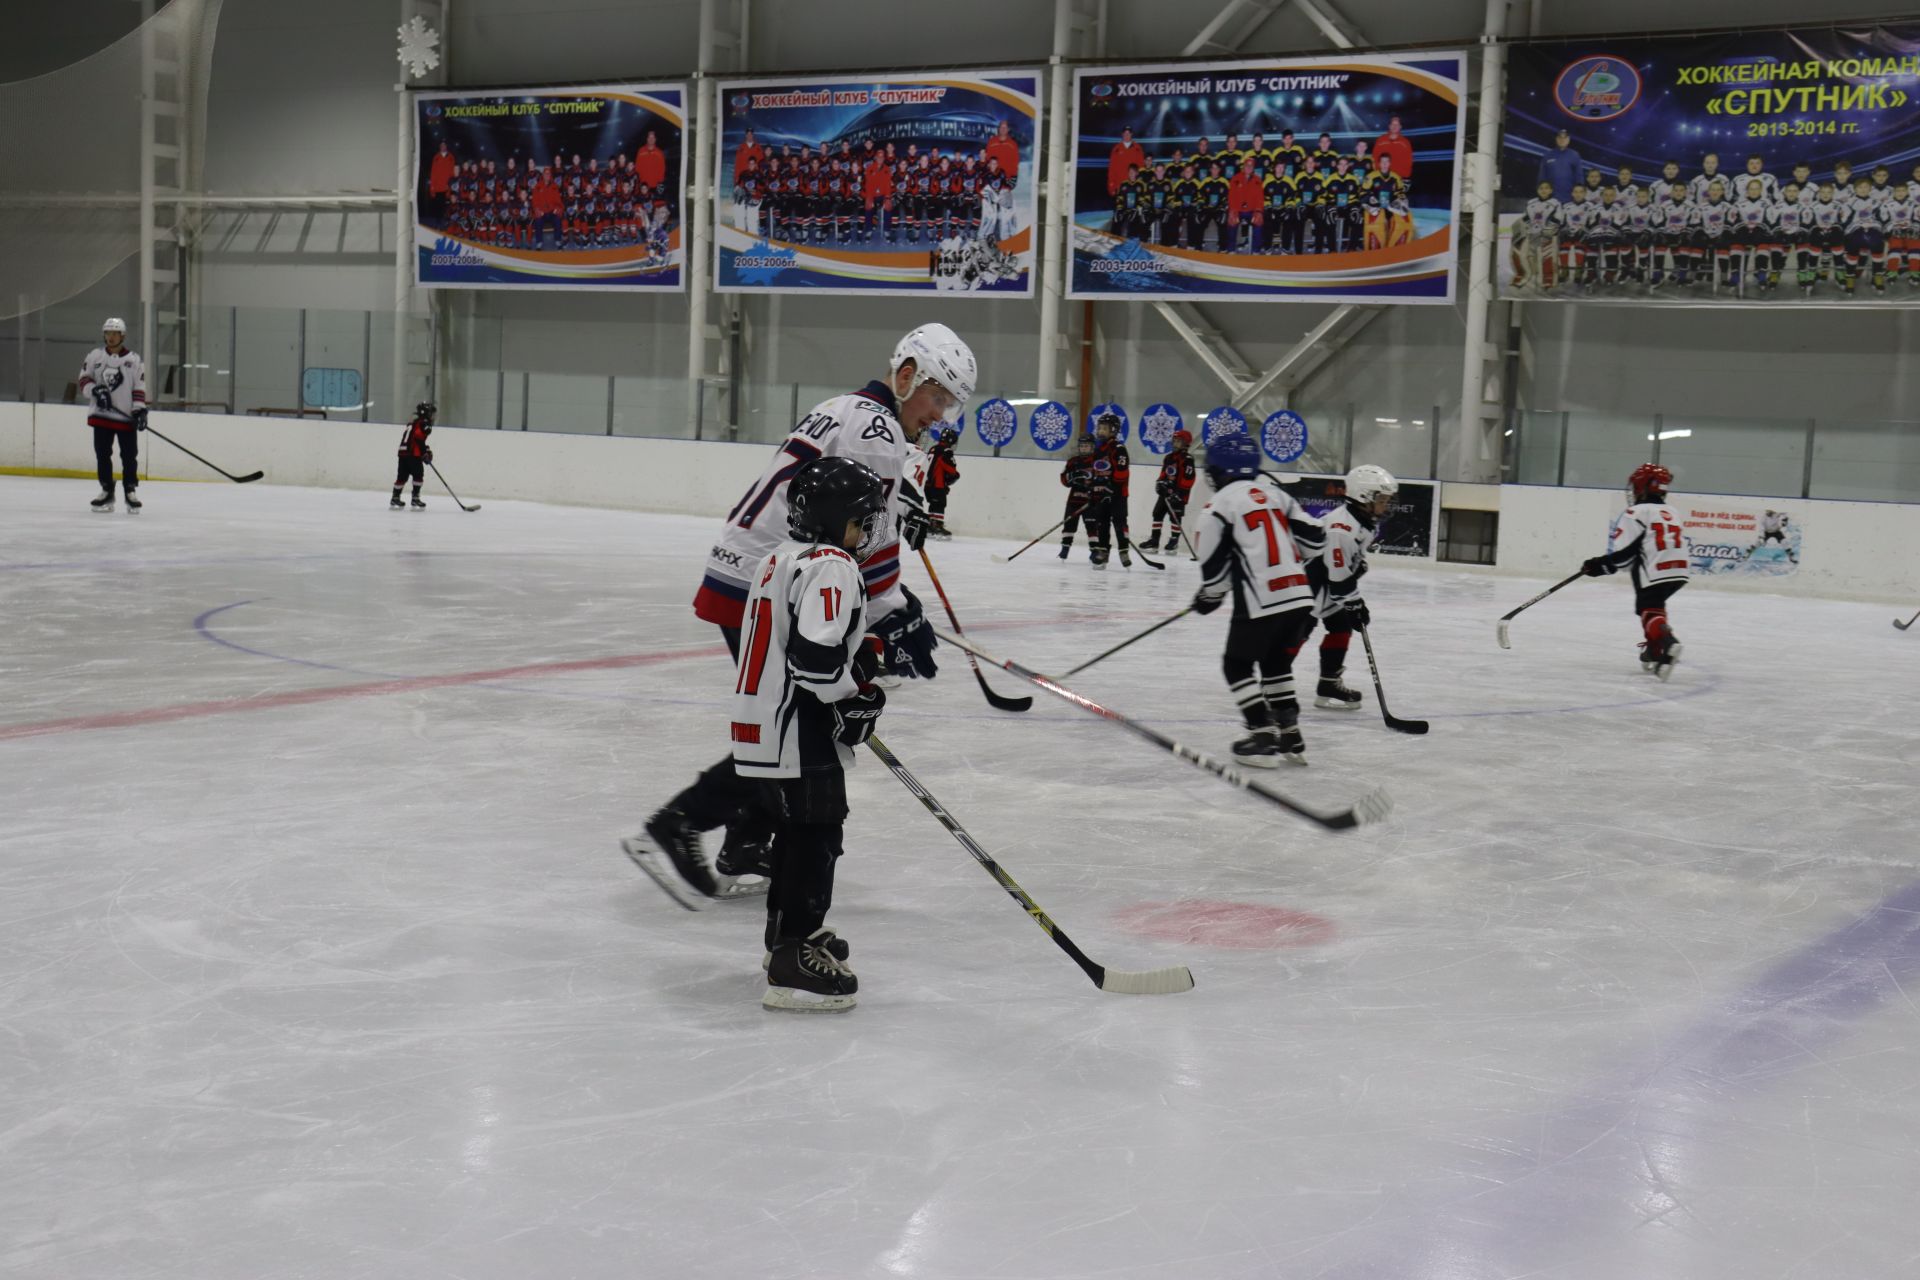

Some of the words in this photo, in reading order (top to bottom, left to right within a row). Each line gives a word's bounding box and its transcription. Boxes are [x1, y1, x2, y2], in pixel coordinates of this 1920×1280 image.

[1676, 58, 1820, 85] ХОККЕЙНАЯ
[1827, 55, 1920, 78] КОМАН
[1117, 77, 1211, 97] ХОККЕЙНЫЙ
[1215, 78, 1256, 93] КЛУБ
[1261, 74, 1349, 91] "СПУТНИК"
[753, 89, 832, 108] ХОККЕЙНЫЙ
[834, 90, 868, 105] КЛУБ
[872, 88, 946, 105] "СПУТНИК"
[1705, 83, 1908, 116] «СПУТНИК»
[444, 102, 509, 118] ХОККЕЙНЫЙ
[512, 103, 540, 116] КЛУБ
[544, 101, 605, 115] "СПУТНИК"
[1746, 120, 1837, 137] 2013-2014
[1332, 548, 1344, 568] 9
